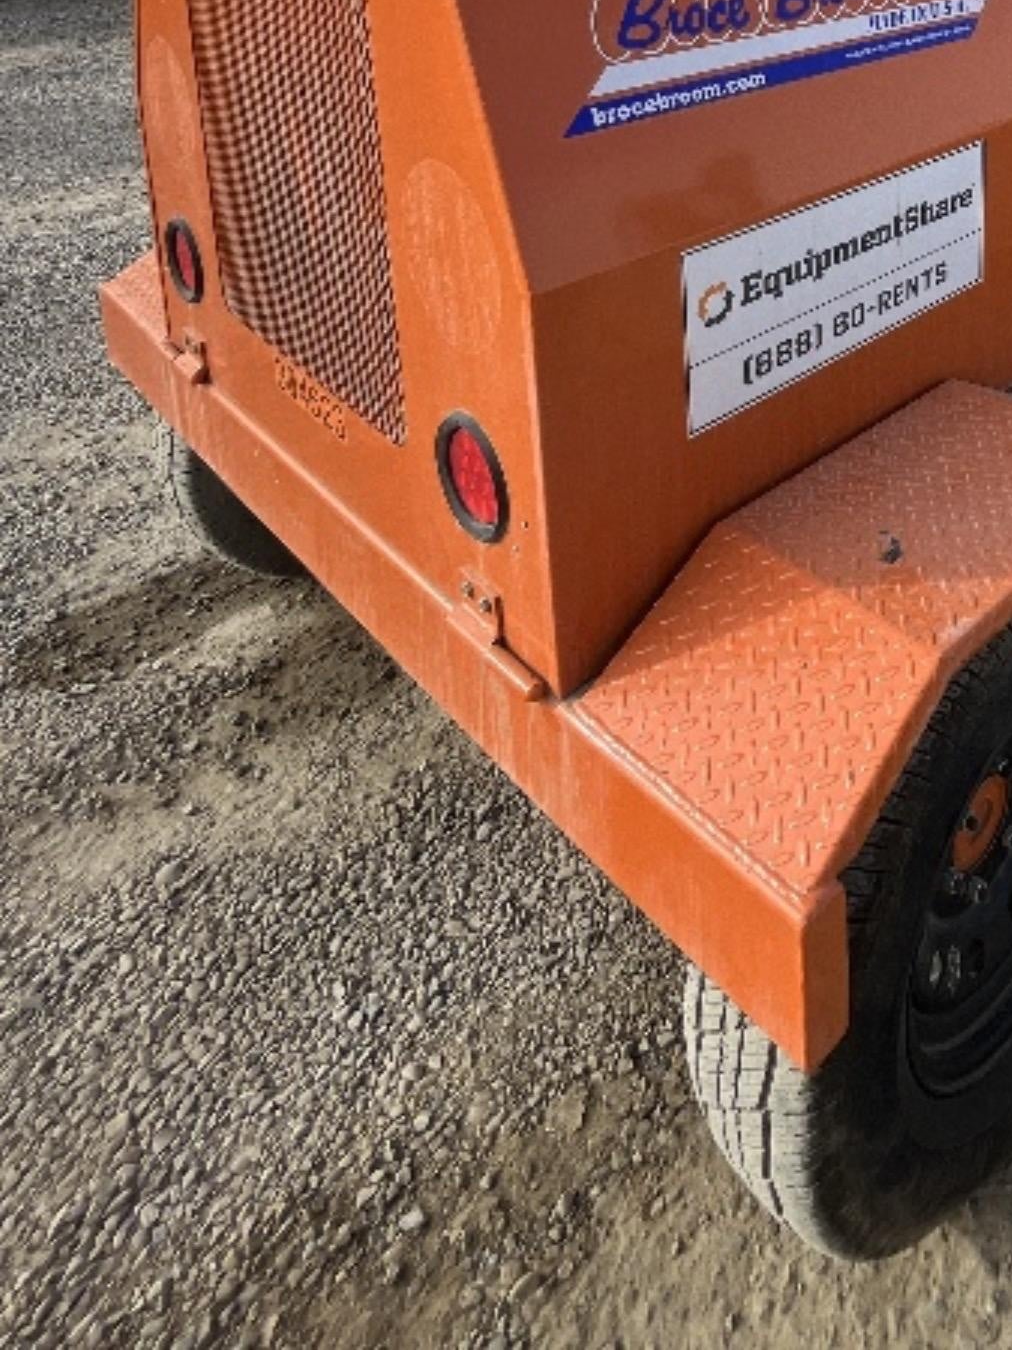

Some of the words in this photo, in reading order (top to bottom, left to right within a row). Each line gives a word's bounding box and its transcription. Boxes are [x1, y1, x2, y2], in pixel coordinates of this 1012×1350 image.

[591, 71, 766, 128] brocebroom.com
[740, 187, 973, 307] EquipmentShare
[742, 322, 824, 385] (888)
[832, 260, 949, 338] 60-RENTS
